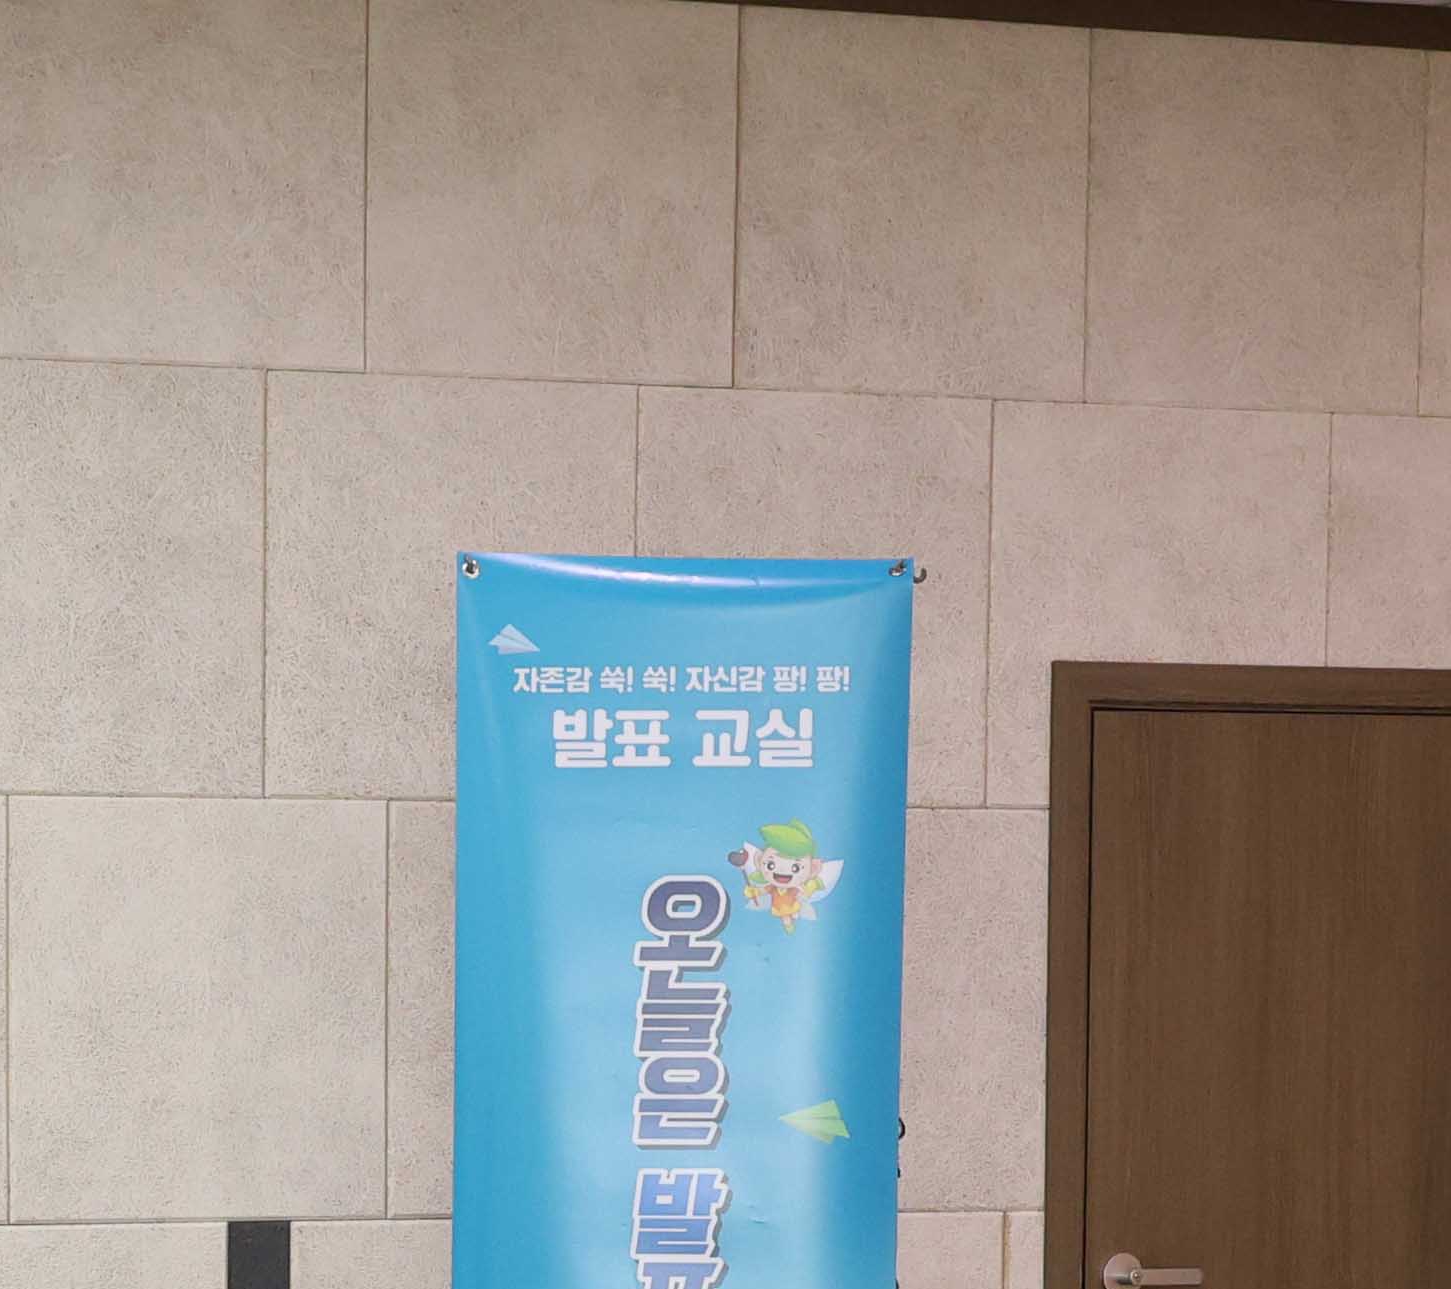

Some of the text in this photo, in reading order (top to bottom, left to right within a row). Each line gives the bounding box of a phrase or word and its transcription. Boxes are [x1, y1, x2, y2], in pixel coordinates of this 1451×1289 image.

[513, 666, 851, 694] 자존감 쑥! 쑥! 자신감 팡! 팡!
[552, 707, 814, 769] 발표 교실
[633, 874, 730, 1148] 오늘은
